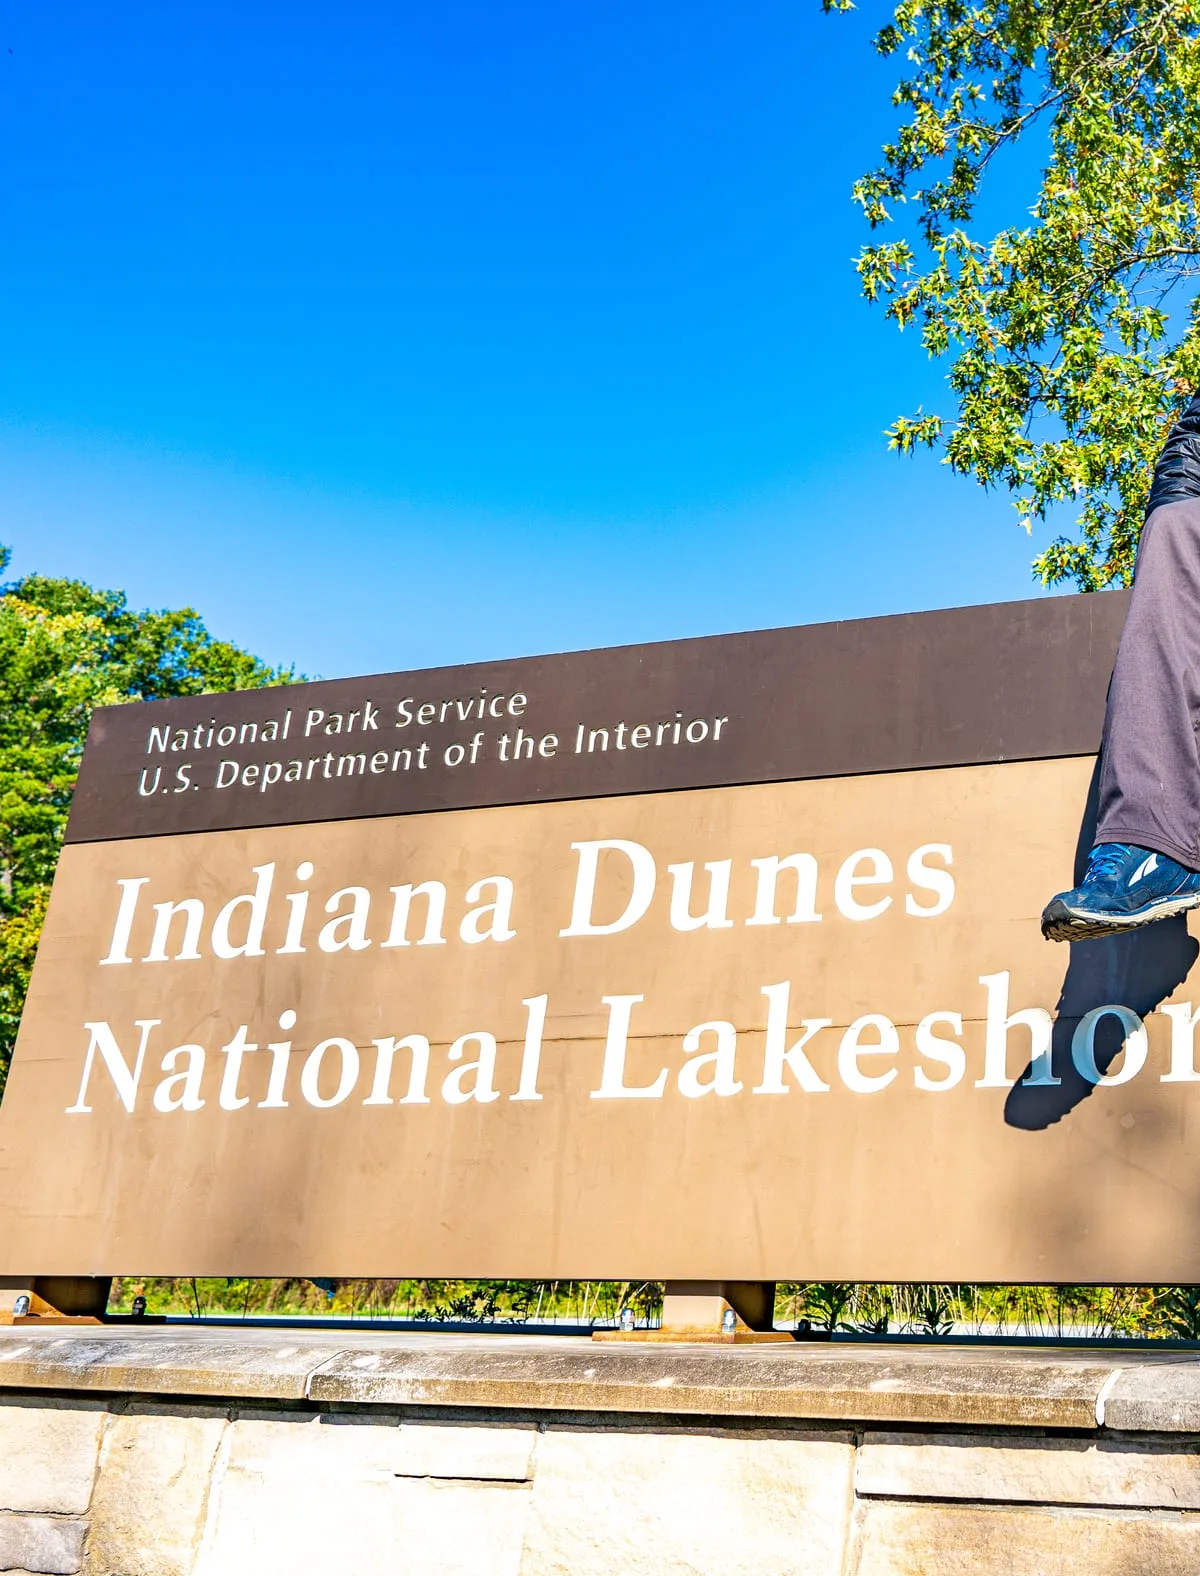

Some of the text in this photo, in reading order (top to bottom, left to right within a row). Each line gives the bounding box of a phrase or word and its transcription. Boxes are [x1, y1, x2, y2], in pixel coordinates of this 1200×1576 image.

[138, 712, 729, 797] U.S. Department of the Interior
[146, 687, 528, 755] National Park Service
[98, 838, 957, 966] Indiana Dunes
[64, 993, 549, 1115] National
